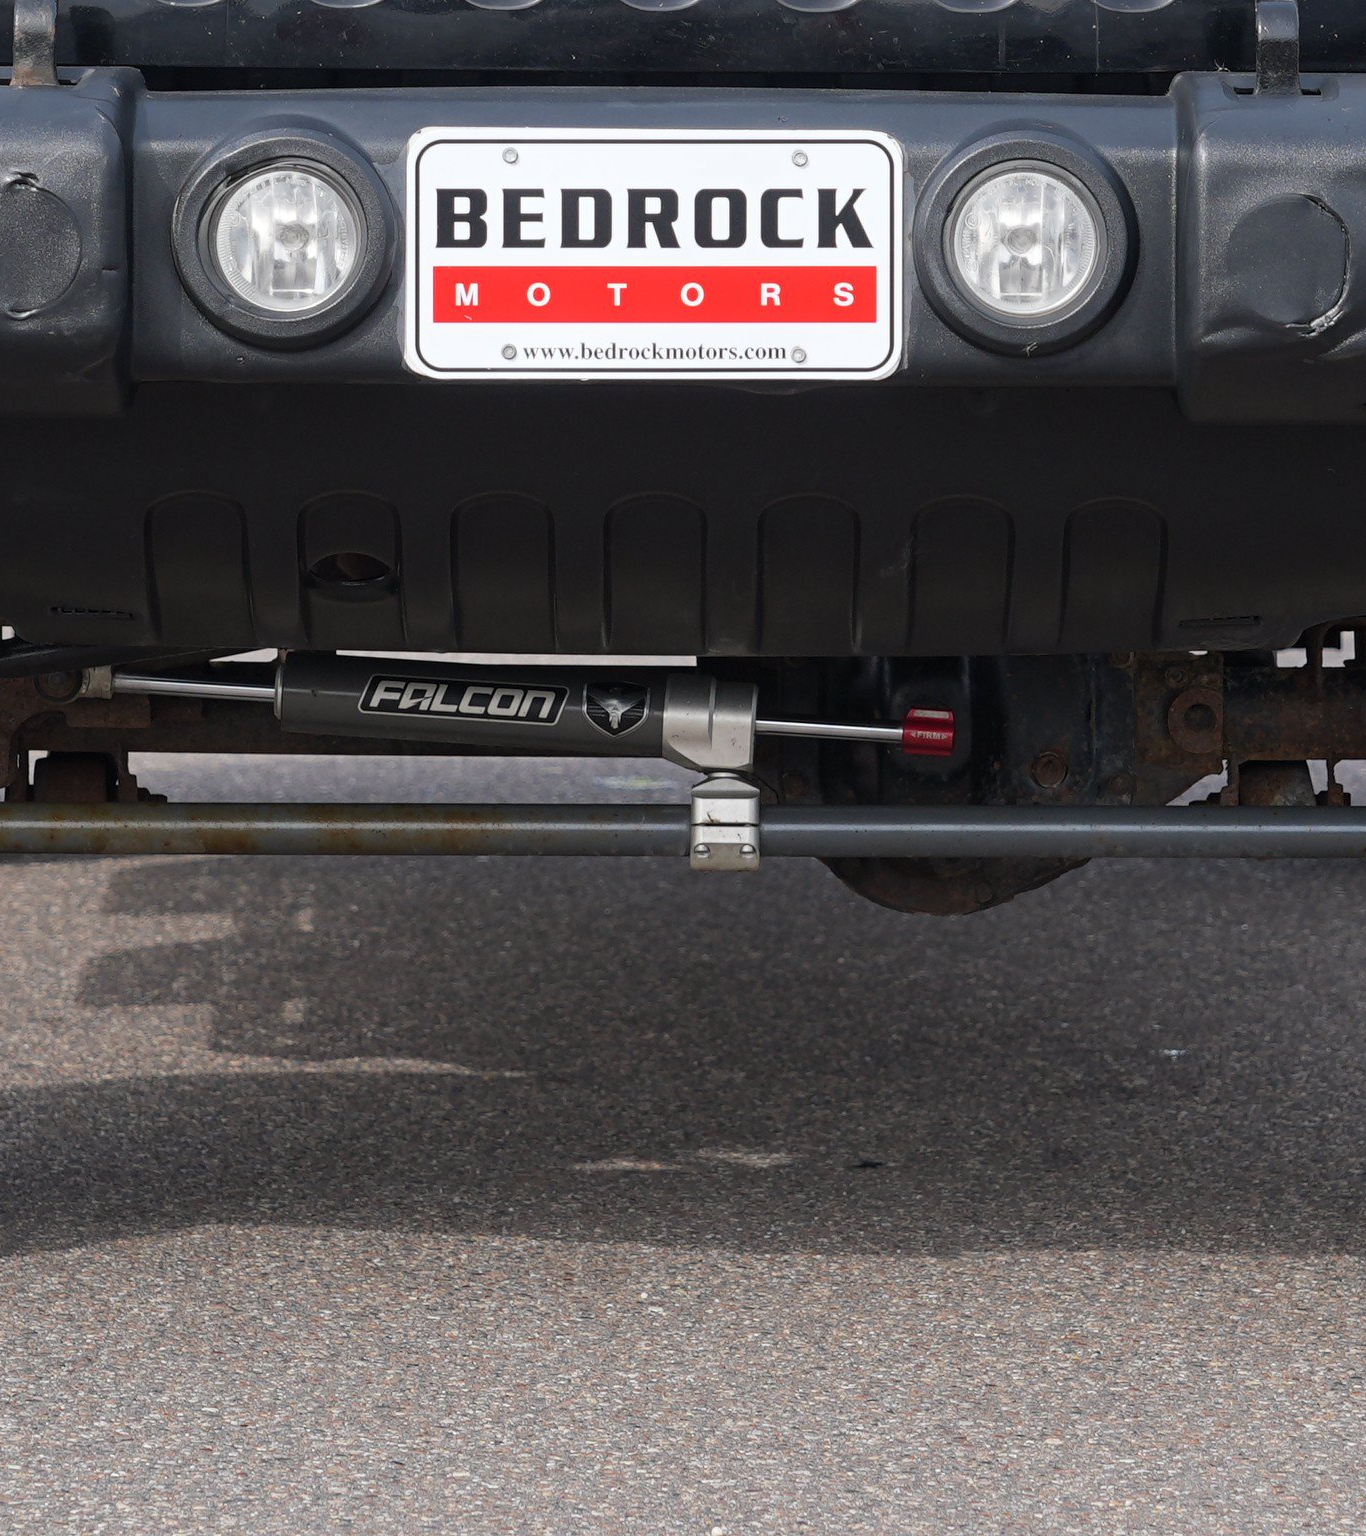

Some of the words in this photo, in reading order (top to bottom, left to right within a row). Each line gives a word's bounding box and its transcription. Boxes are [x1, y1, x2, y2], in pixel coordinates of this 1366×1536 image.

[435, 188, 874, 249] BEDROCK
[455, 282, 855, 307] MOTORS
[523, 342, 787, 361] www.bedrockmotors.com
[369, 680, 556, 719] FALCON
[917, 730, 942, 740] FIRM
